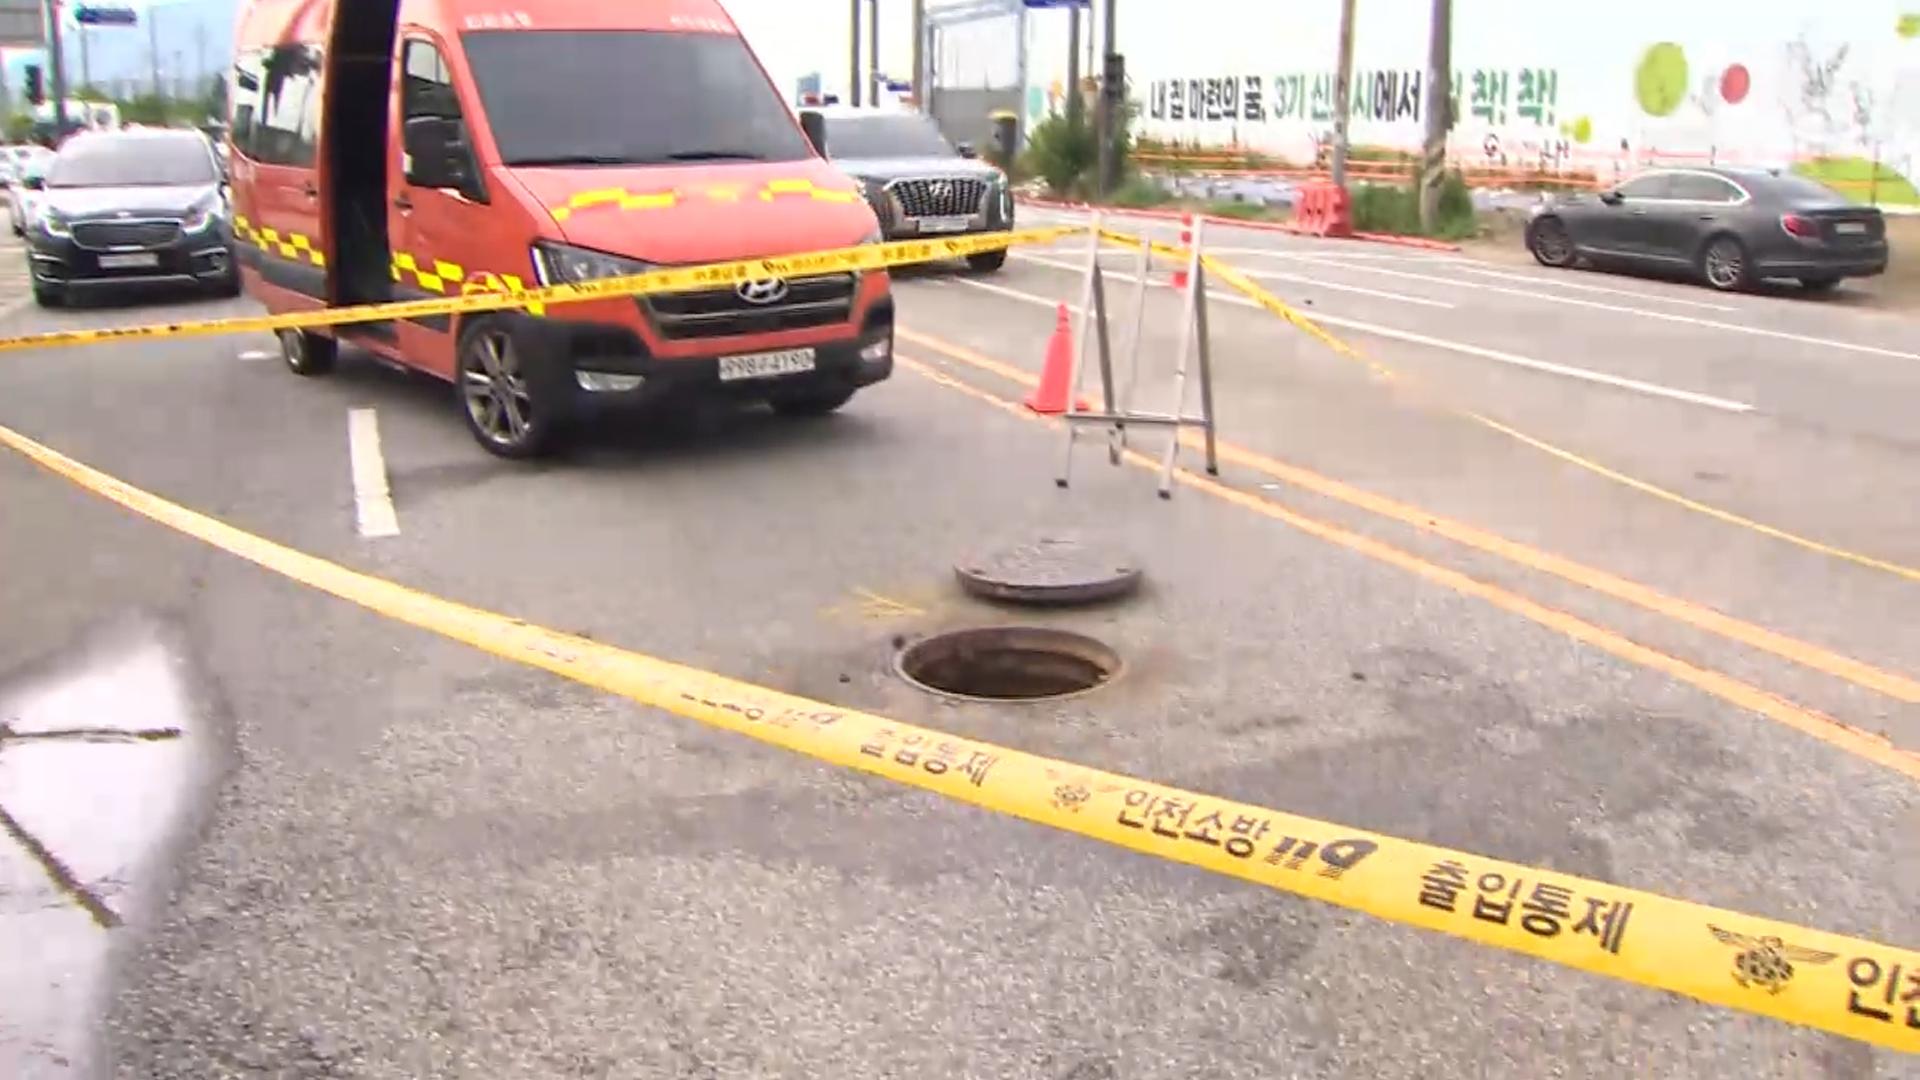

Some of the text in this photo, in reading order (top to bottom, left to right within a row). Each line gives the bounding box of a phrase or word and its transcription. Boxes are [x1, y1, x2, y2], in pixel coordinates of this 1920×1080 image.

[1151, 80, 1167, 121] 내
[1170, 78, 1186, 121] 집
[1189, 75, 1239, 121] 마련의
[1244, 75, 1266, 123] 꿈,
[1274, 74, 1305, 120] 3기
[1310, 70, 1421, 122] 신시에서
[1117, 789, 1271, 859] 인천소방
[1418, 858, 1635, 956] 출입통제
